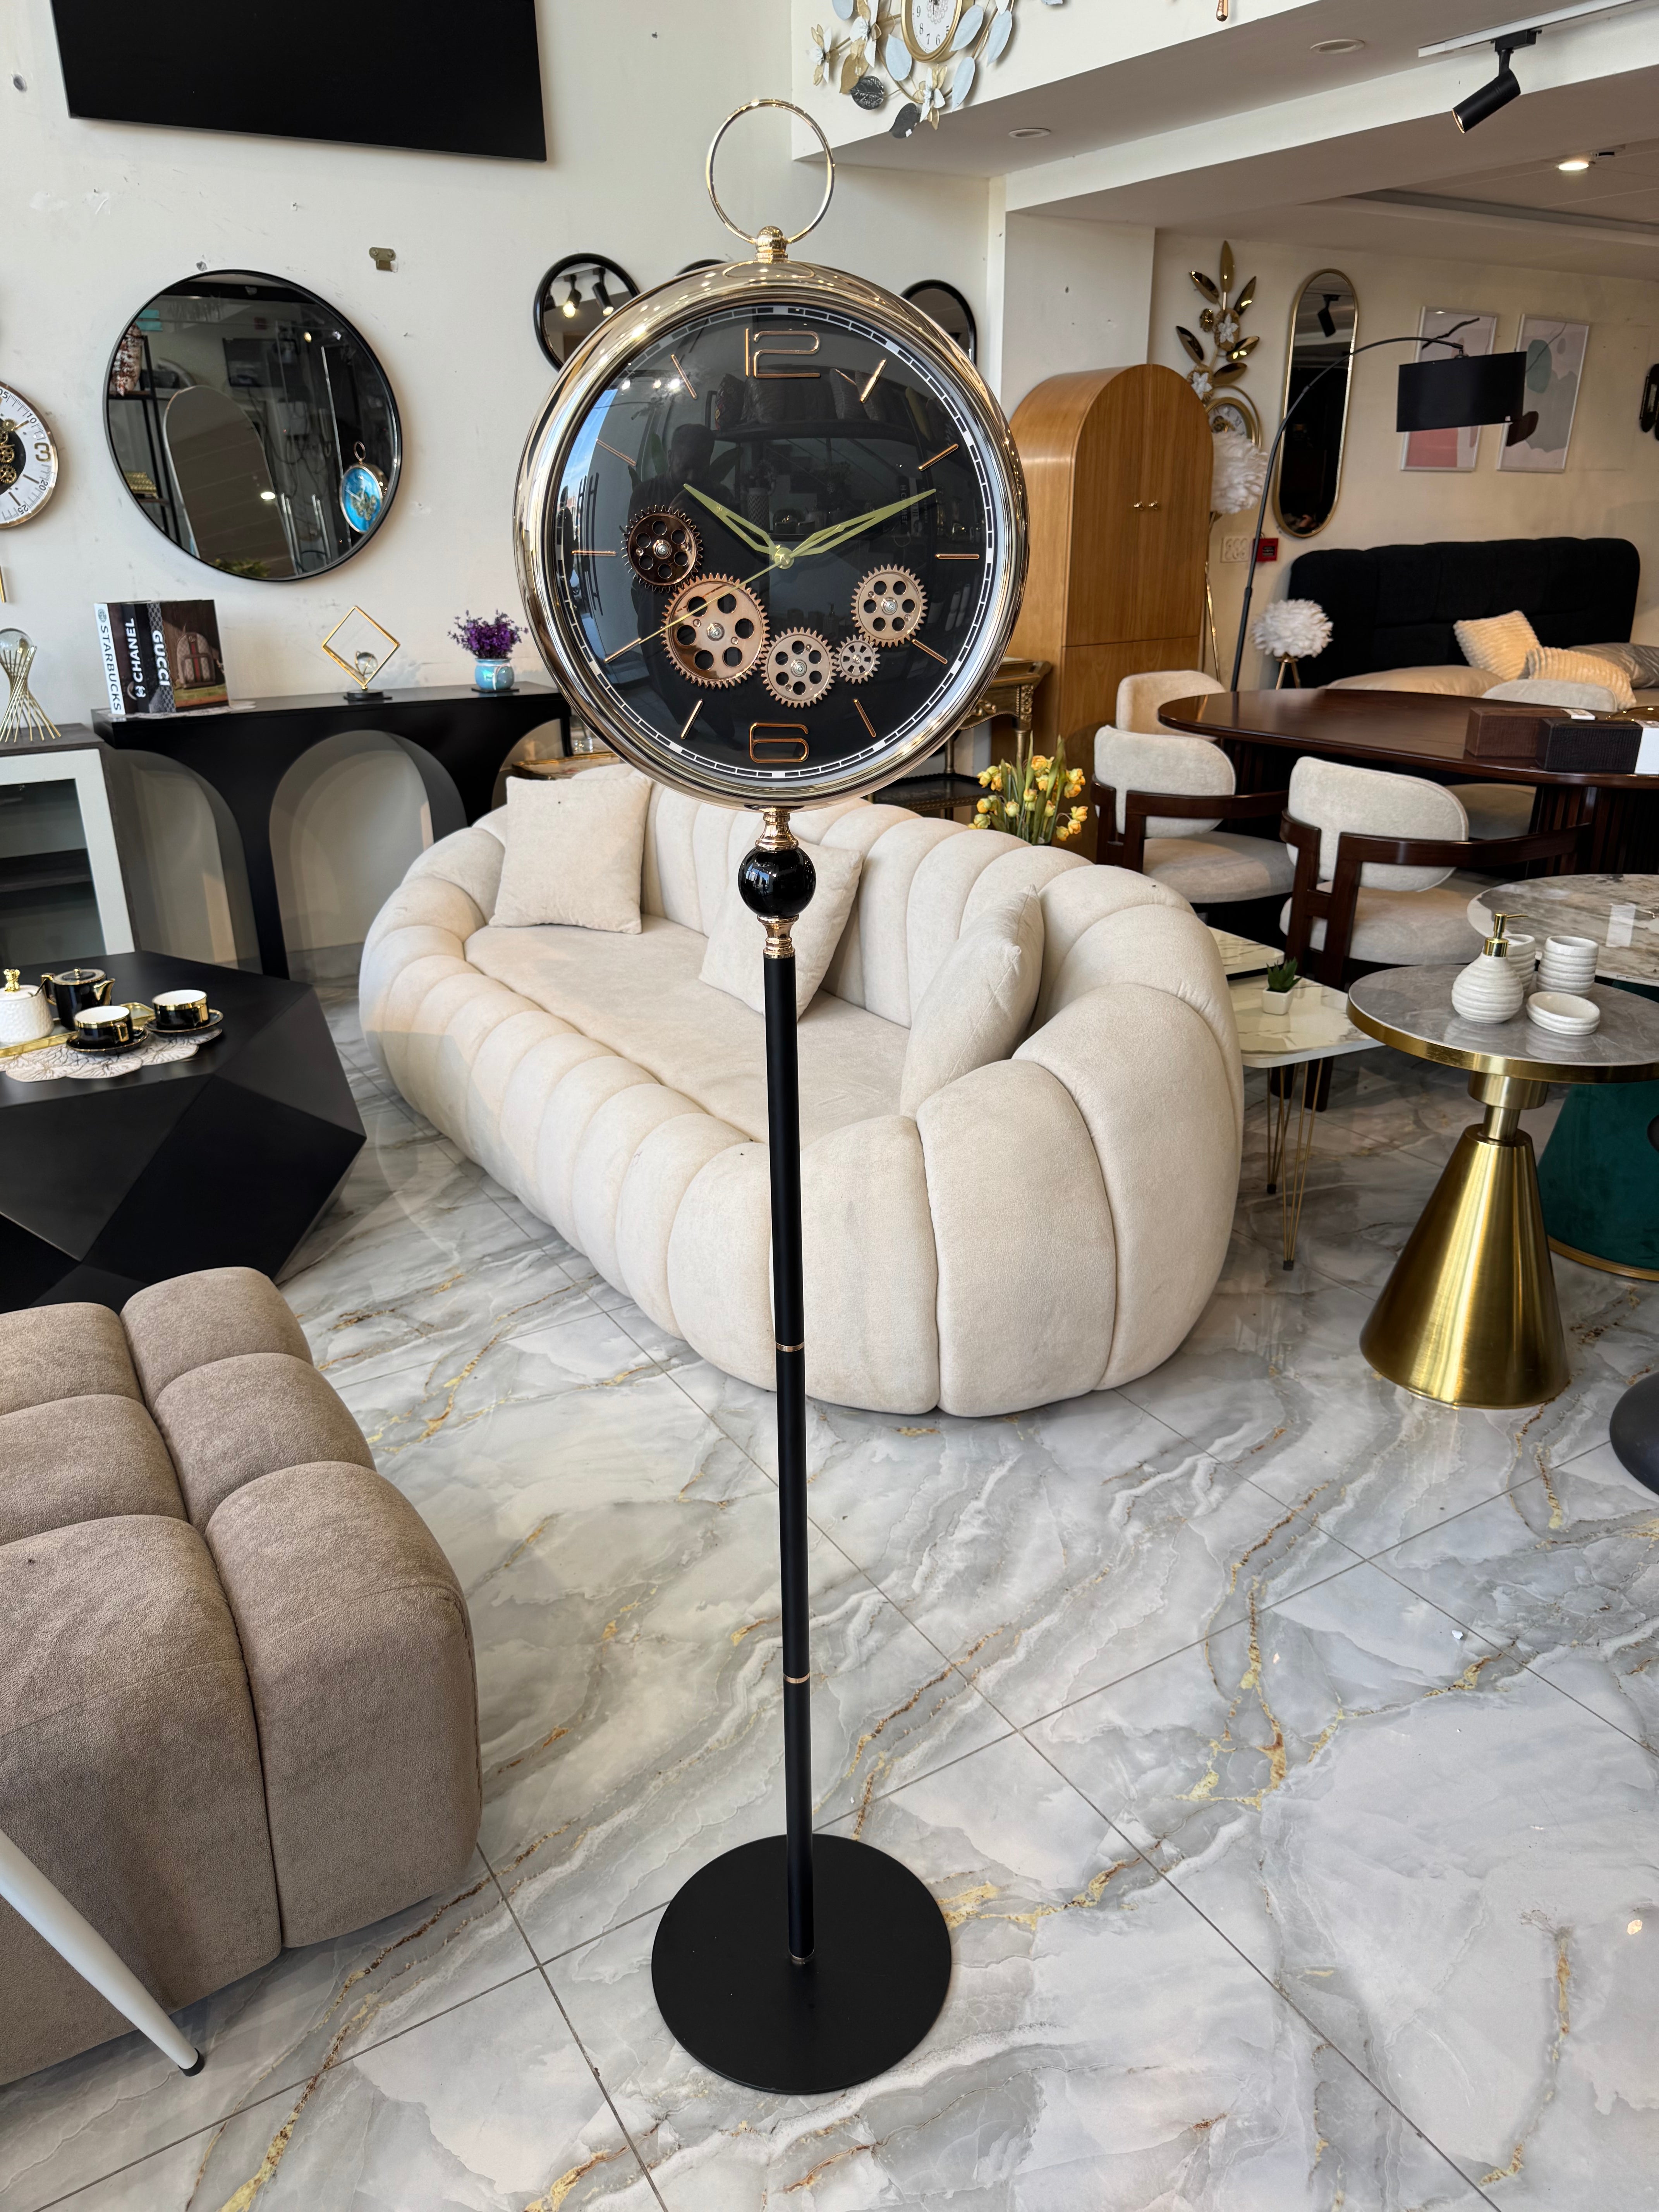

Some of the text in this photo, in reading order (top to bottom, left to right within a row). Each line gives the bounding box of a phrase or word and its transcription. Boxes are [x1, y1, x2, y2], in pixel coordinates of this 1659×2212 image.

[917, 5, 921, 17] 9
[919, 23, 924, 34] 8
[926, 33, 930, 45] 7
[936, 34, 940, 46] 6
[745, 328, 820, 378] 12
[27, 413, 37, 424] 10
[34, 443, 51, 462] 3
[39, 479, 48, 491] 20
[17, 505, 29, 515] 25
[125, 618, 143, 682] CHANEL
[153, 630, 170, 686] GUCCI
[101, 625, 122, 710] STARBUCKS
[750, 723, 809, 763] 6
